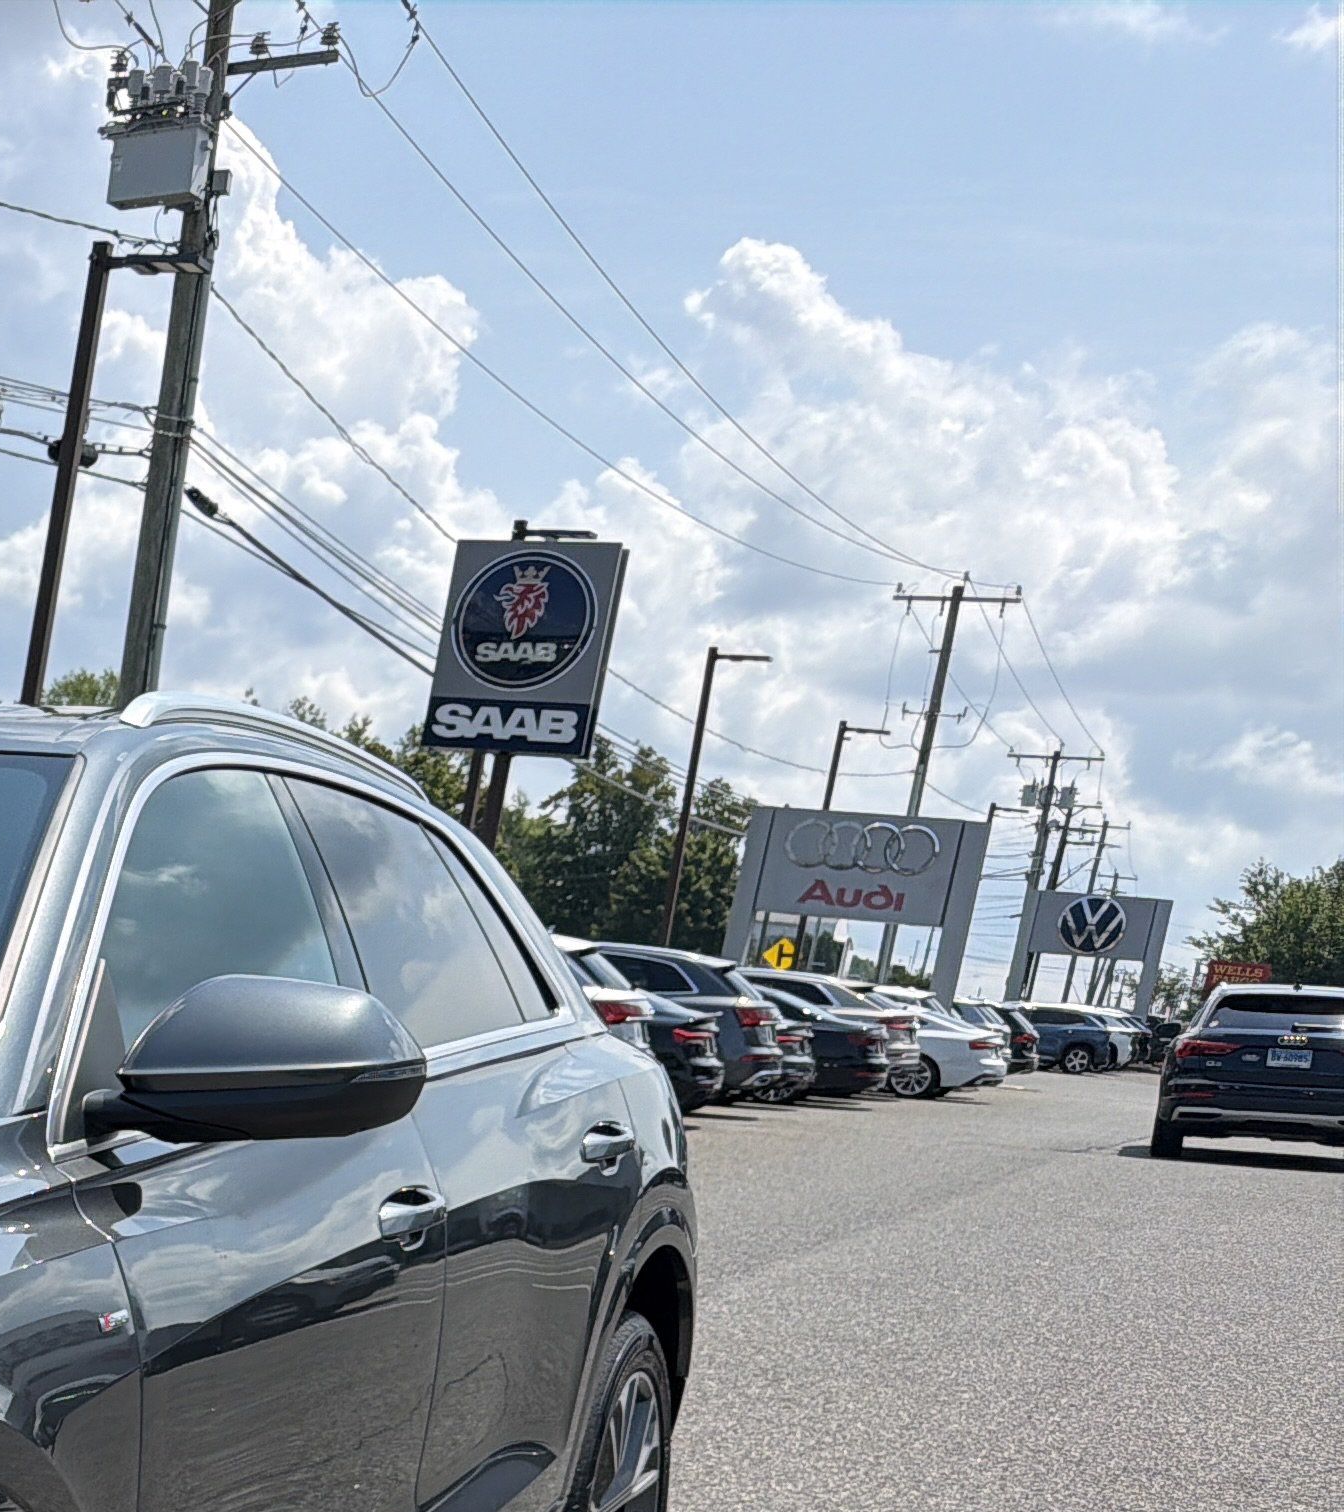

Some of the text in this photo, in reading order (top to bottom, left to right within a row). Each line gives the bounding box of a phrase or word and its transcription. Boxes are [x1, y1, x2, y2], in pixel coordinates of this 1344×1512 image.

[475, 642, 557, 663] SAAB
[432, 703, 579, 744] SAAB
[796, 879, 906, 913] Audi
[1214, 964, 1264, 978] WELLS
